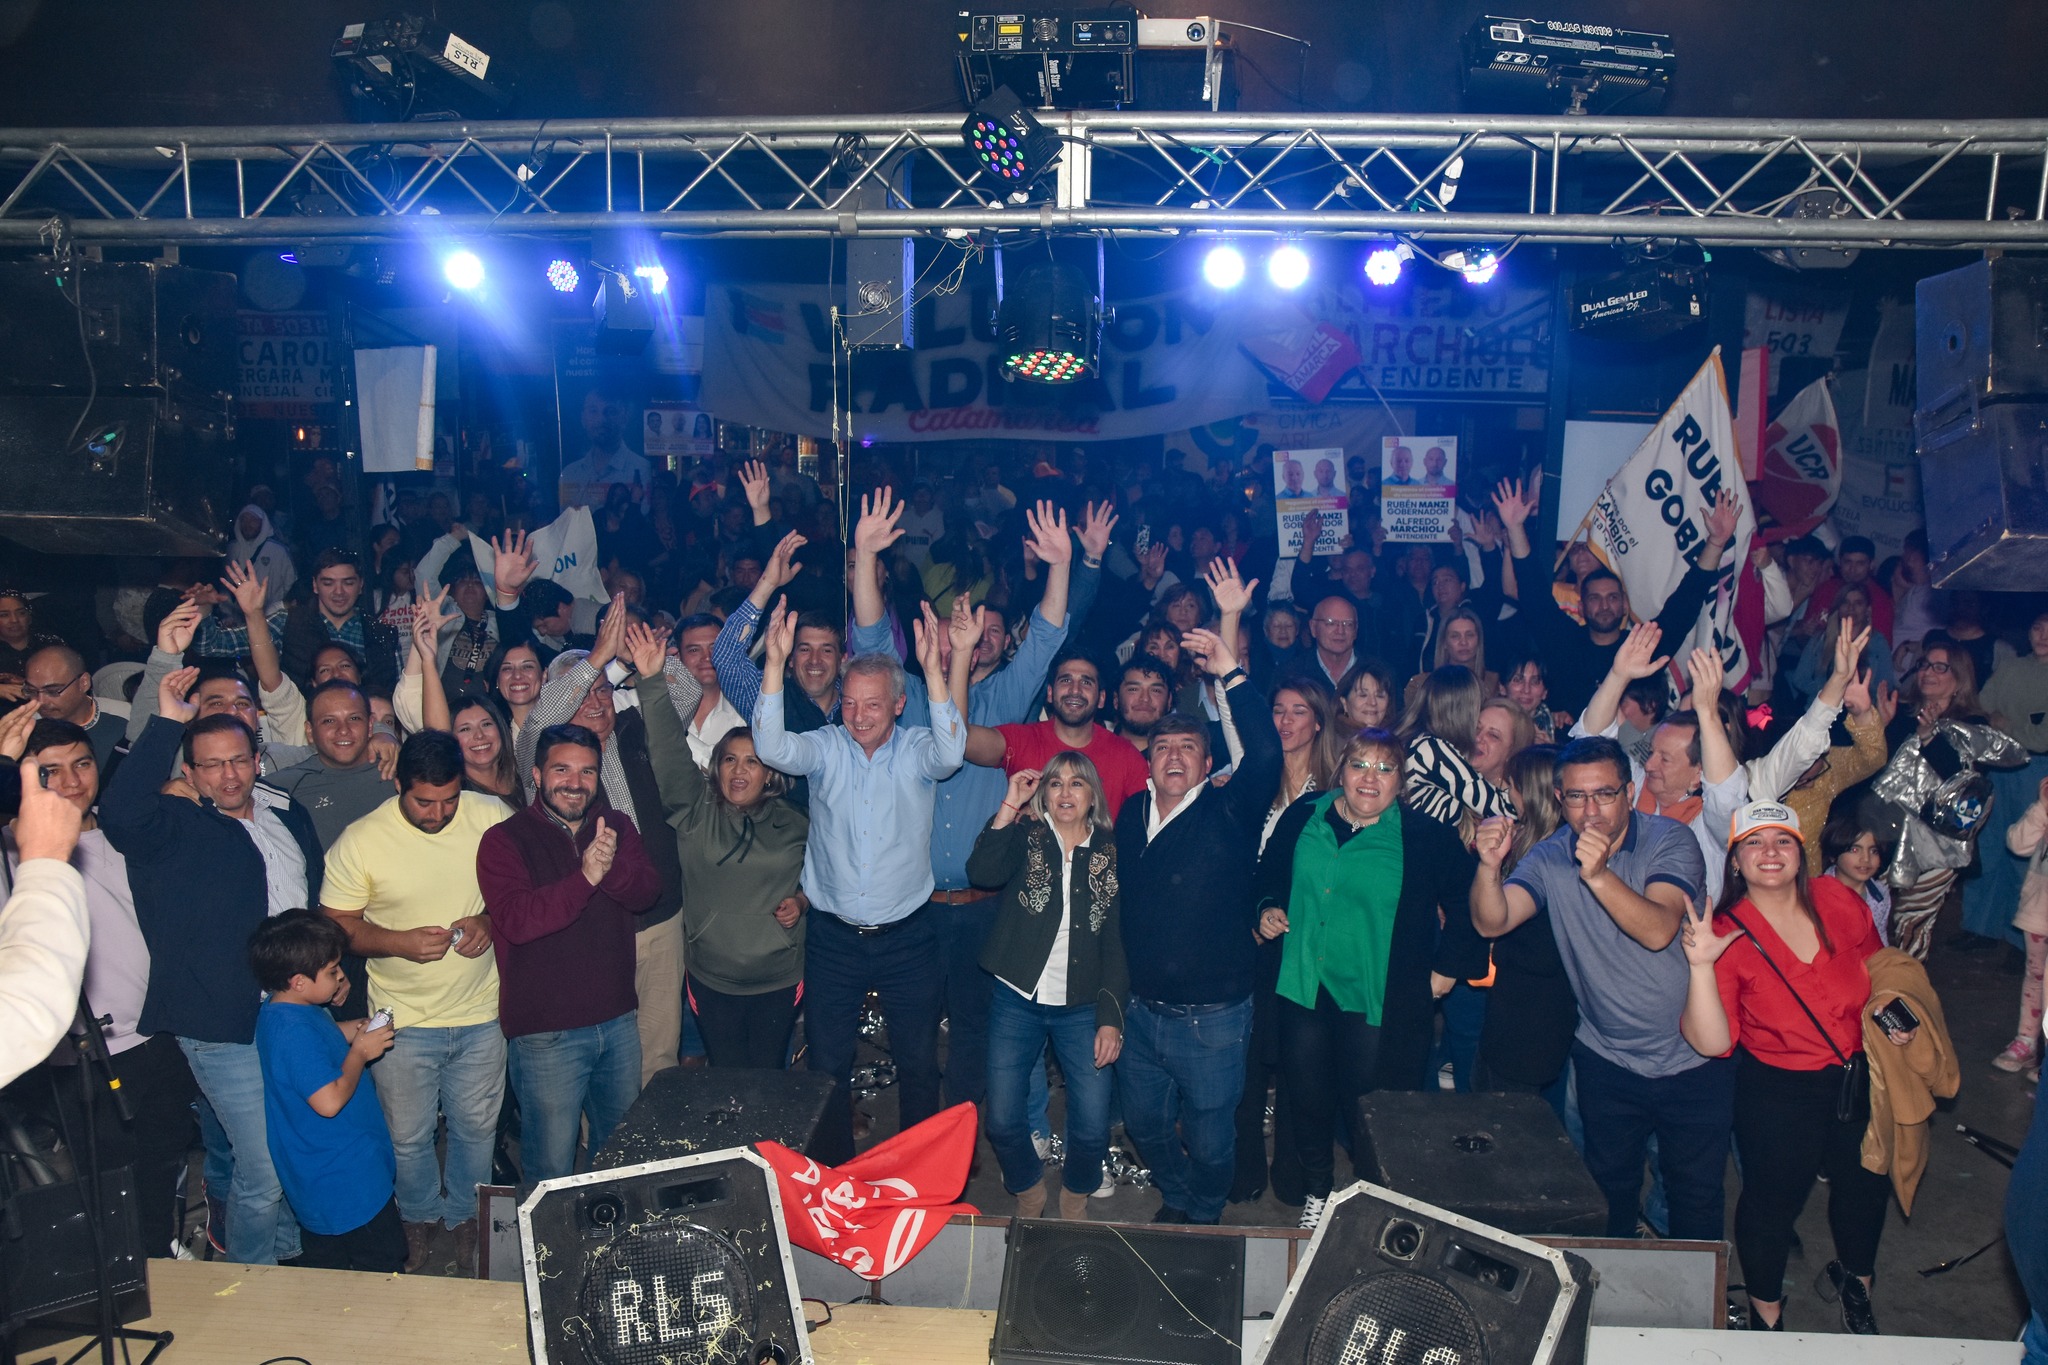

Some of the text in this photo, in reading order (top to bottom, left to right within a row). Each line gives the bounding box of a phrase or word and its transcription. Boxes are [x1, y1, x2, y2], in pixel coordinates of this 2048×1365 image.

[454, 49, 478, 70] RLS
[1580, 299, 1608, 314] DUAL
[1606, 295, 1630, 307] GEM
[1590, 306, 1624, 321] American
[240, 341, 333, 366] CAROL
[1766, 331, 1813, 355] 503
[1279, 432, 1310, 449] ARI
[1786, 433, 1830, 480] UCR
[1418, 500, 1449, 508] MANZI
[1390, 525, 1445, 533] MARCHIOLI
[1395, 517, 1440, 525] ALFREDO
[1618, 518, 1631, 535] por
[1629, 537, 1640, 548] el
[553, 552, 577, 574] ON
[612, 1270, 731, 1346] RLS
